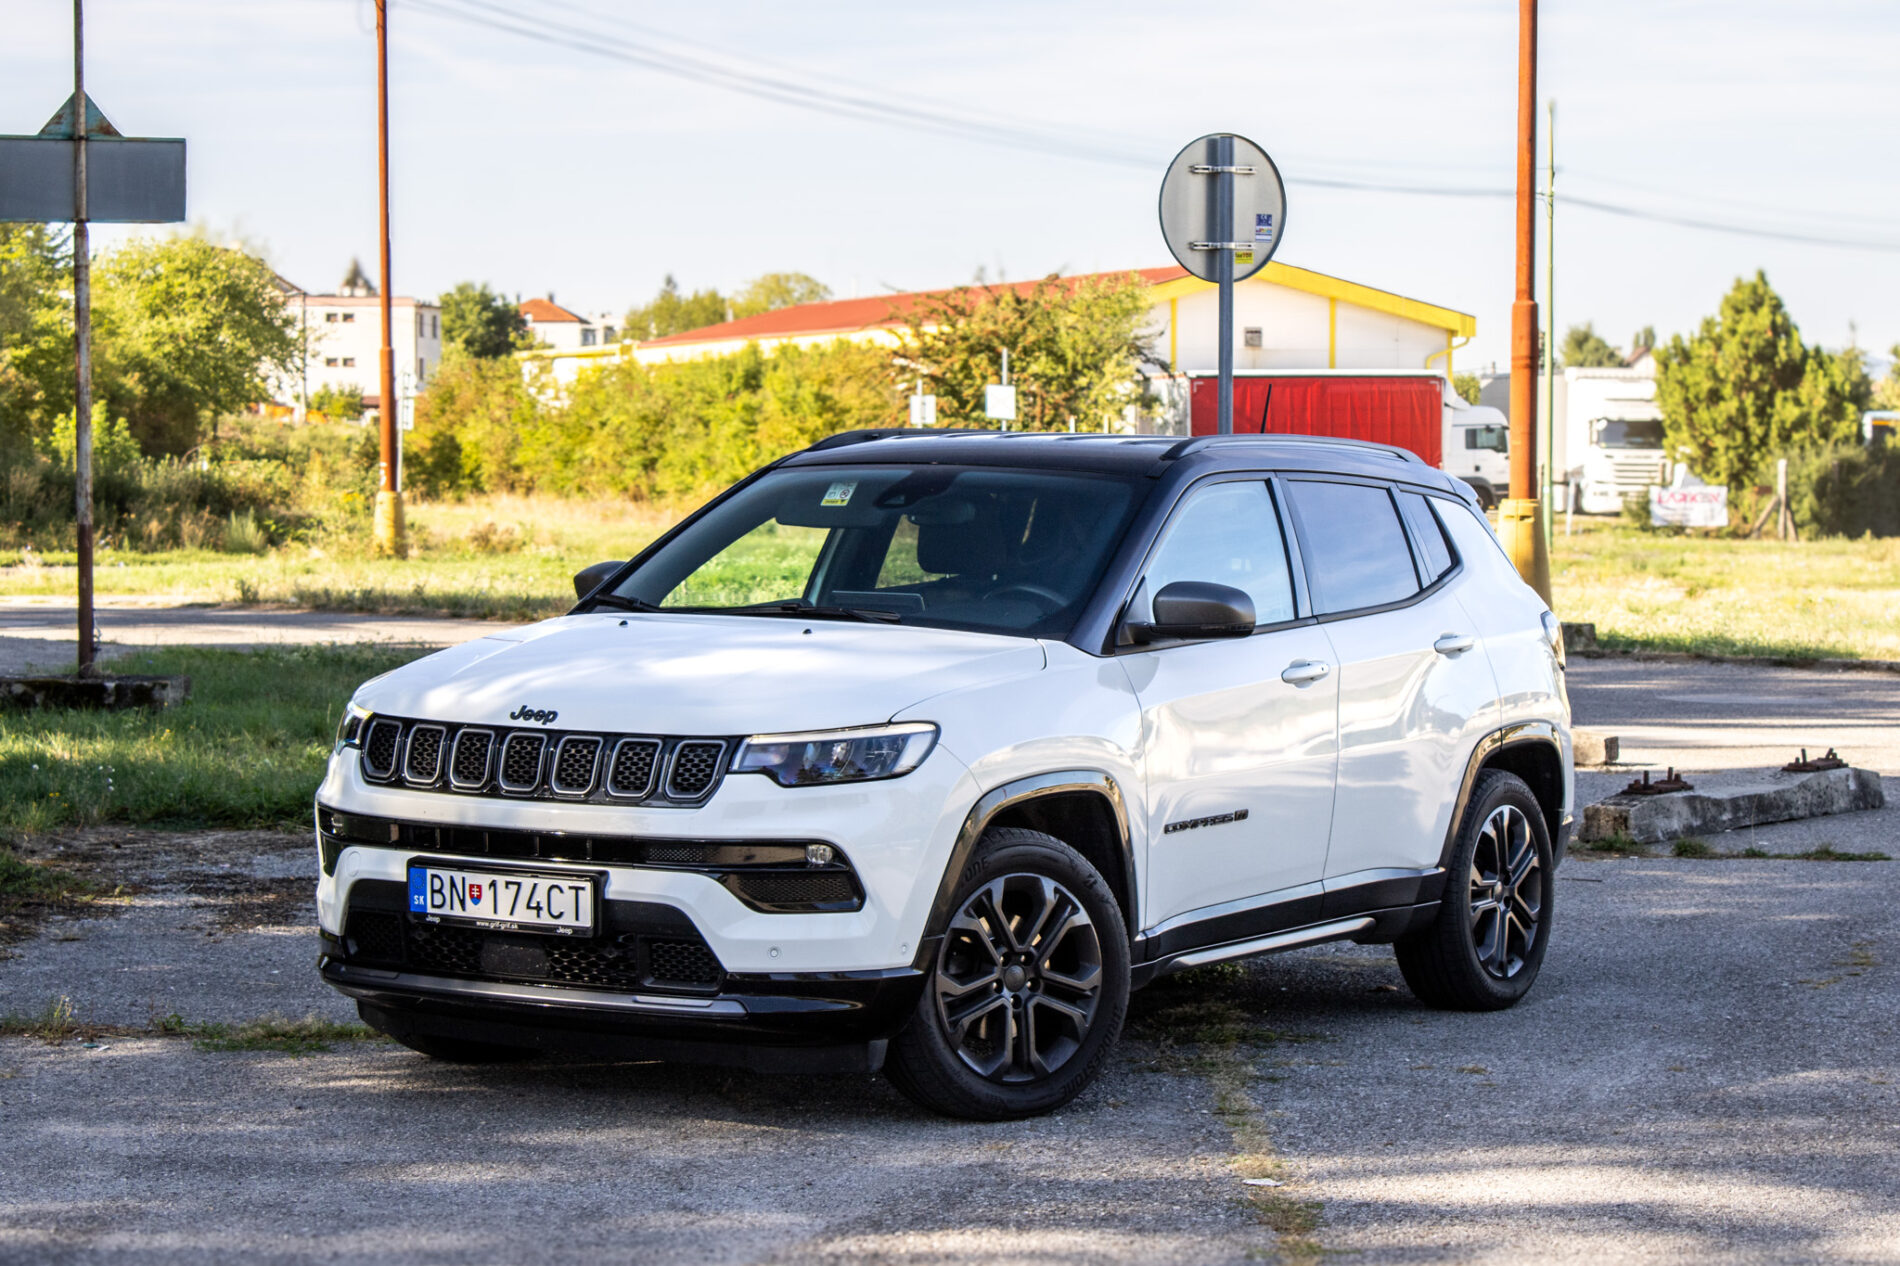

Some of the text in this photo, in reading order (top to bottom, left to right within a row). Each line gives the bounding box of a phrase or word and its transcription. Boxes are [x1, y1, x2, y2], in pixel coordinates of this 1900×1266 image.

[510, 705, 558, 725] Jeep
[413, 895, 425, 905] SK
[426, 914, 441, 924] Jeep
[556, 926, 573, 935] Jeep
